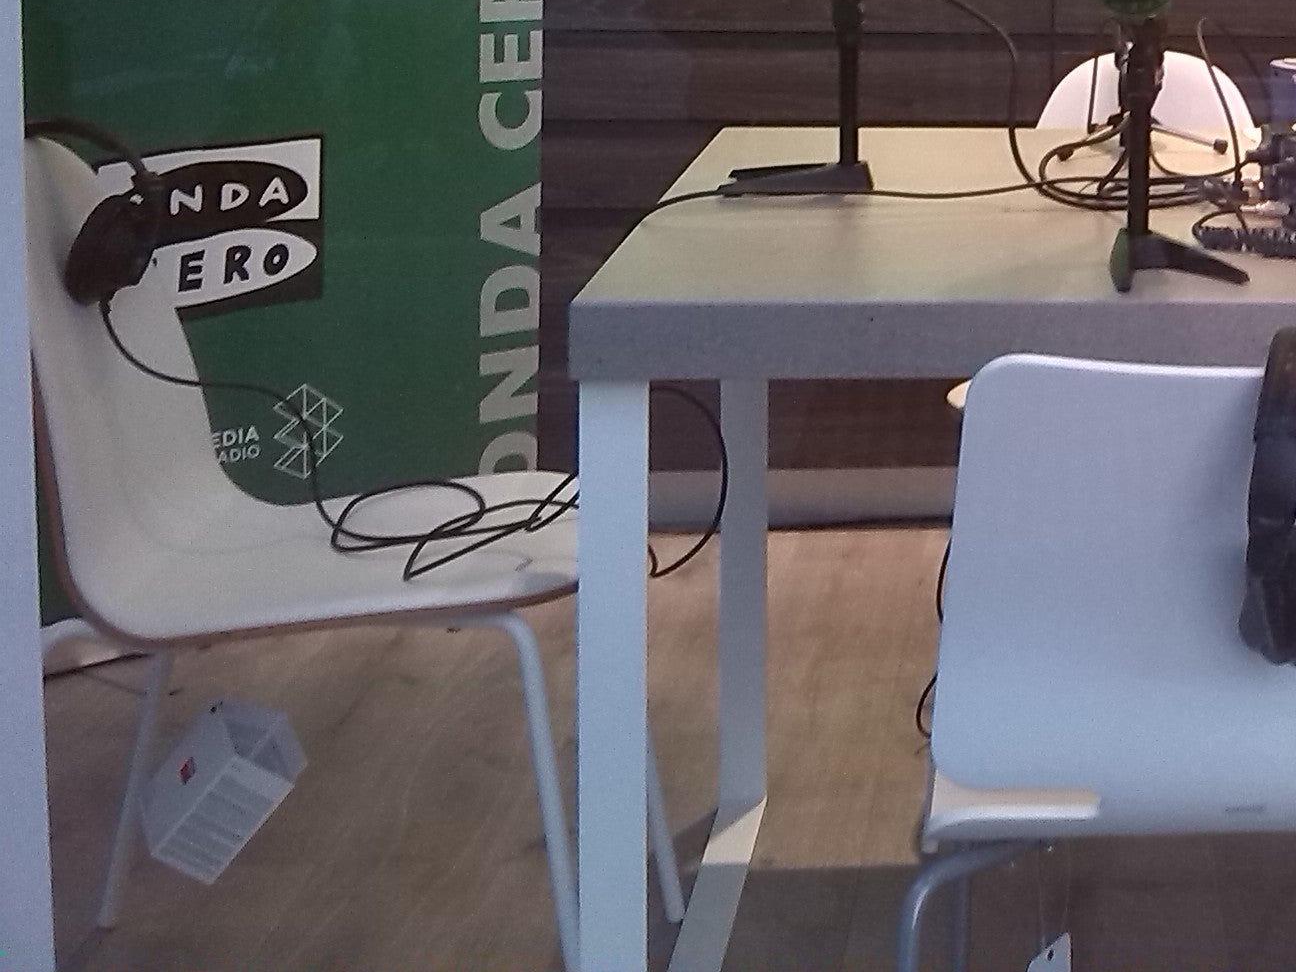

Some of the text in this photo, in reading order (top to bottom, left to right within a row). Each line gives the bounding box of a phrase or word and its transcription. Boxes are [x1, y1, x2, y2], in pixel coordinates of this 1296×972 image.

[170, 176, 290, 216] NDA
[178, 243, 290, 293] ERO
[212, 425, 260, 449] EDIA
[218, 444, 261, 464] ADIO
